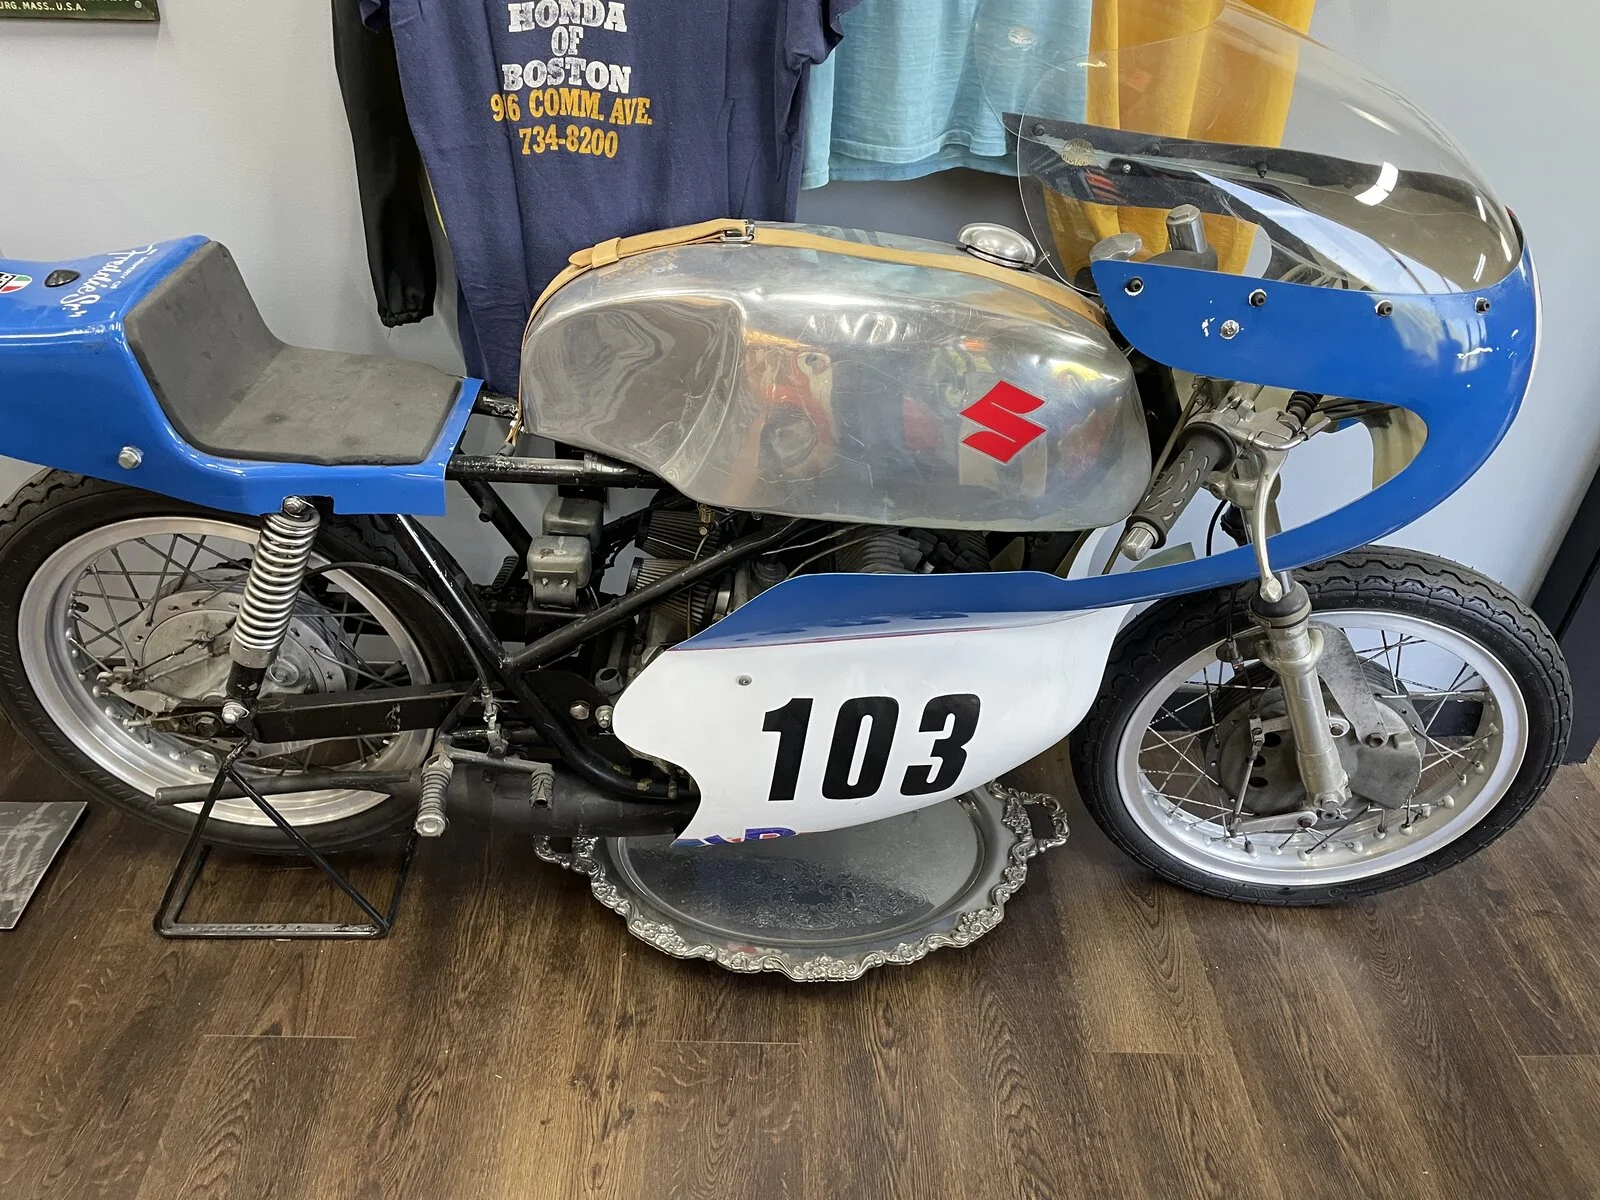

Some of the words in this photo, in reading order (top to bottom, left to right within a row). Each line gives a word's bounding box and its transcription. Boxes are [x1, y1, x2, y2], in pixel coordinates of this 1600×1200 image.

[56, 2, 87, 12] U.S.A.
[508, 0, 627, 32] HONDA
[551, 26, 584, 56] OF
[502, 57, 631, 93] BOSTON
[529, 88, 604, 120] COMM.
[609, 97, 653, 125] AVE.
[519, 124, 618, 158] 734-8200
[762, 694, 981, 801] 103
